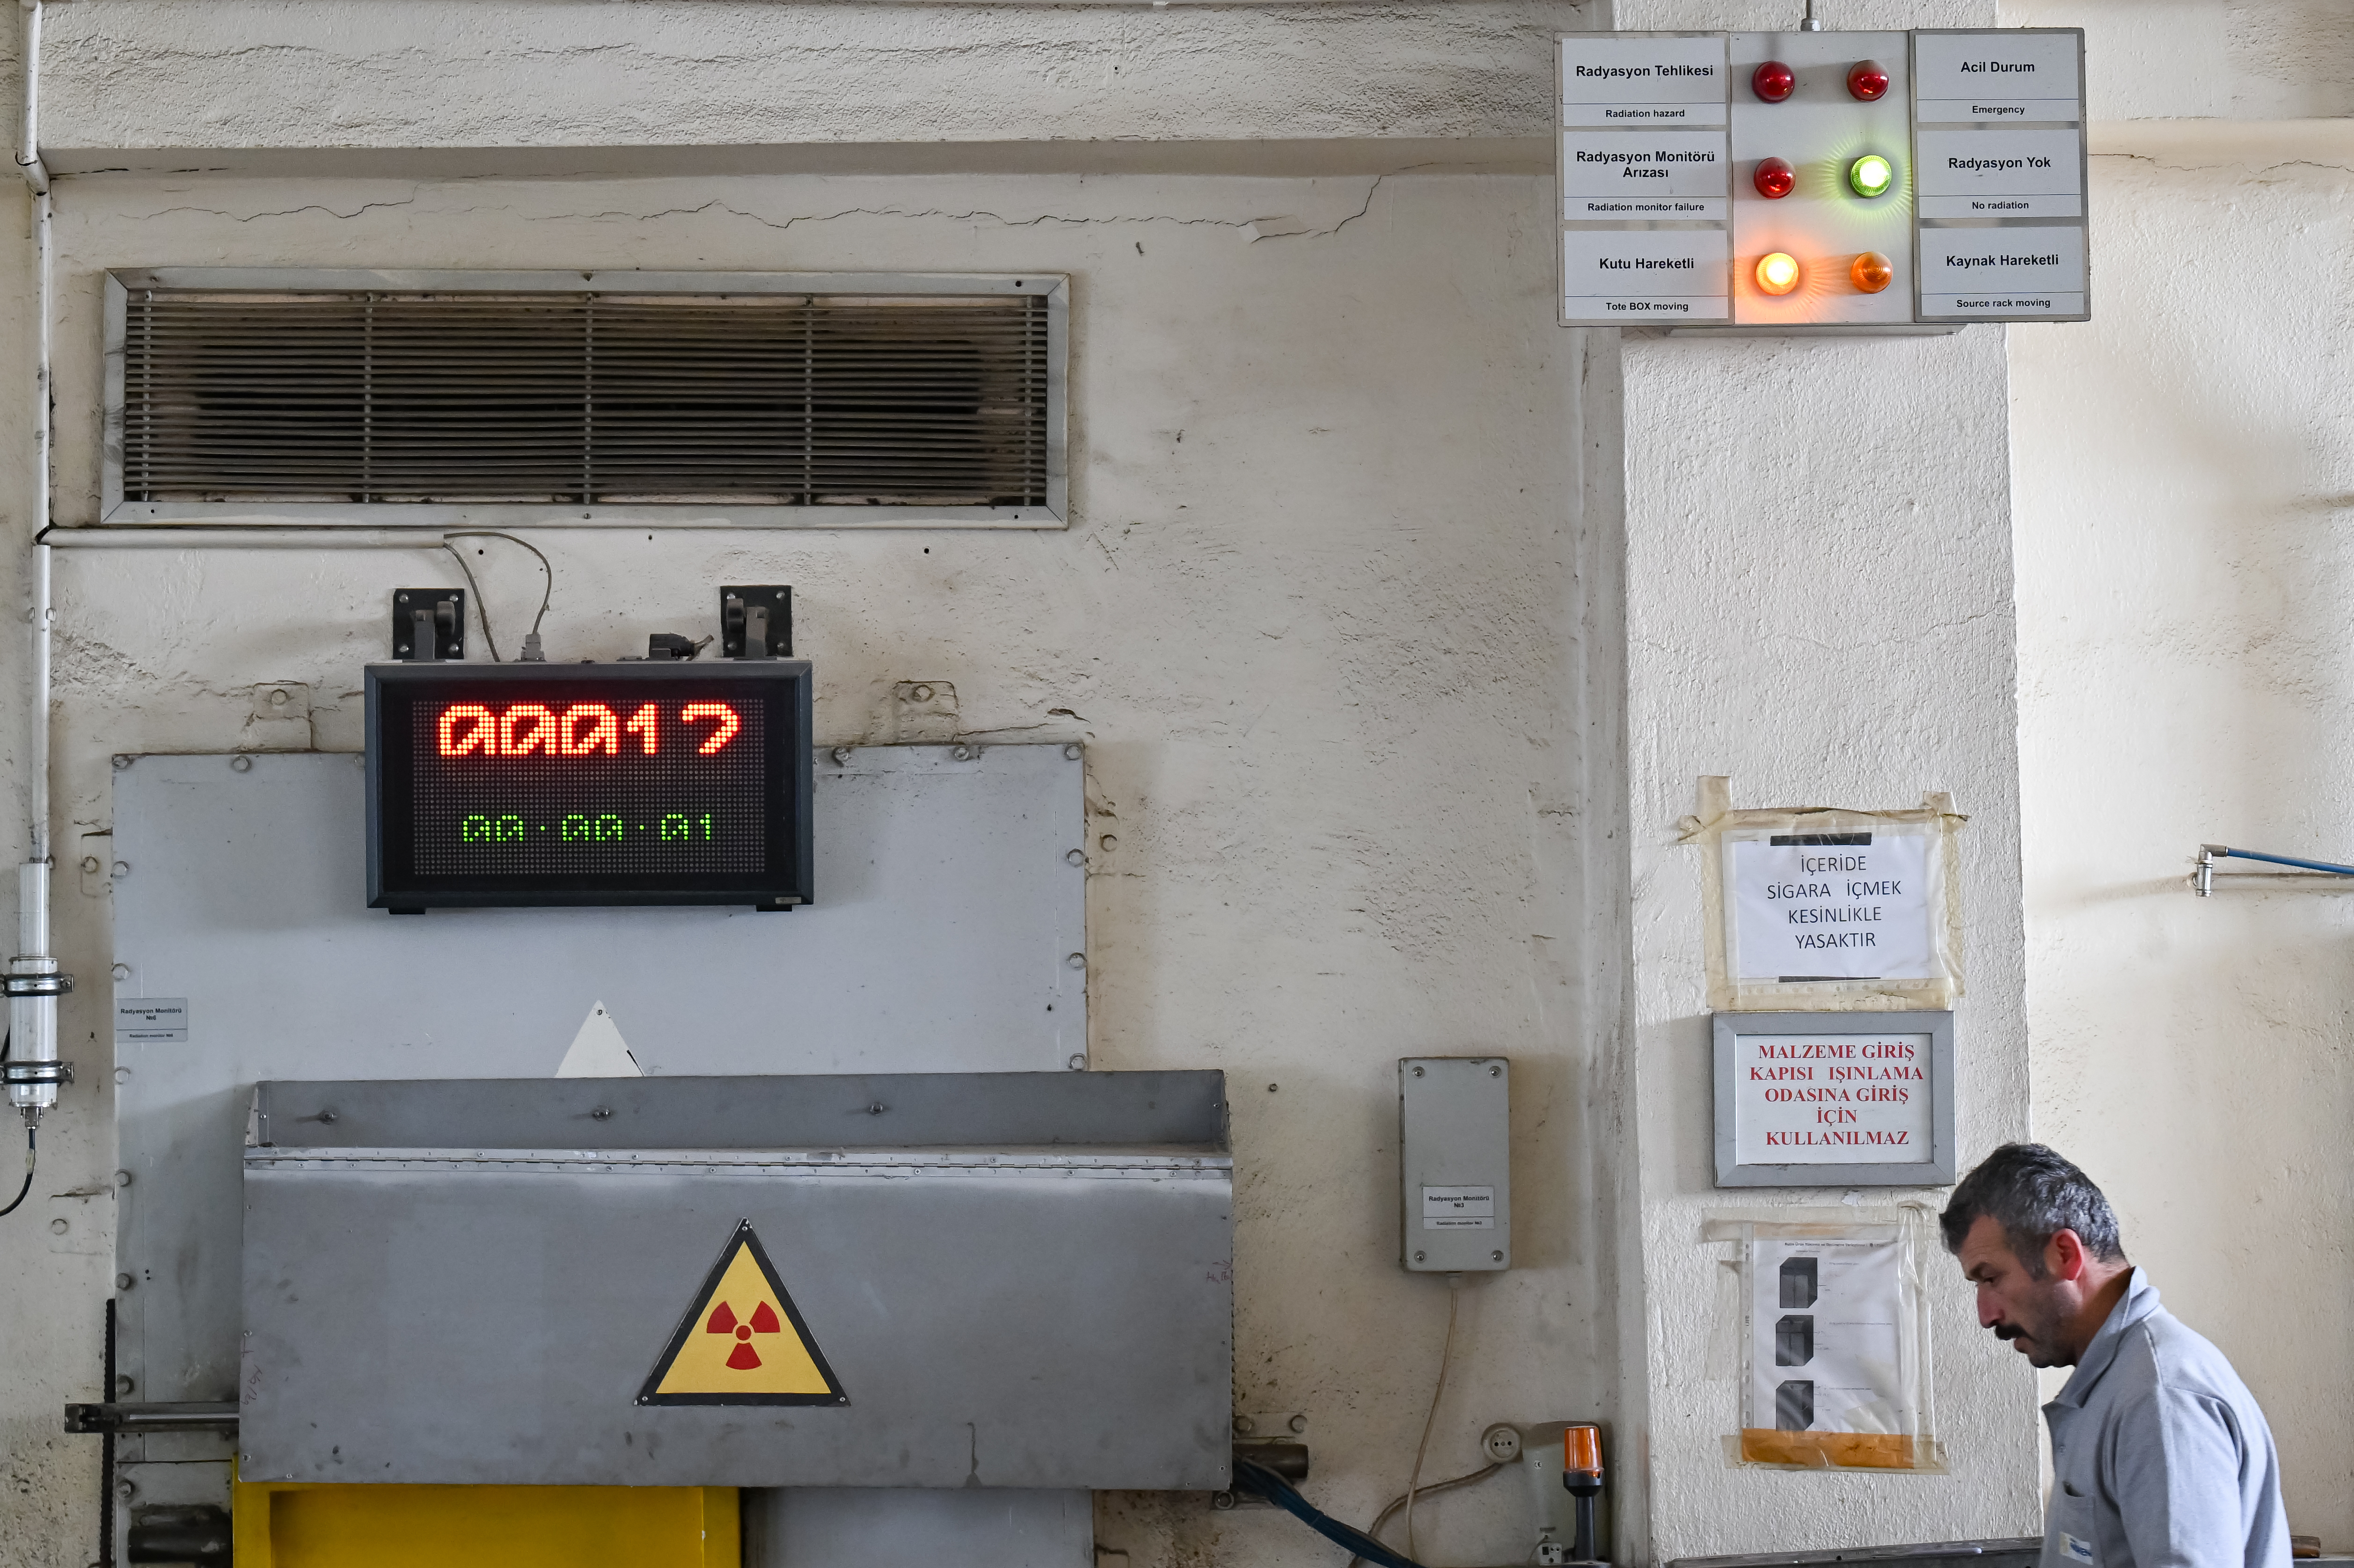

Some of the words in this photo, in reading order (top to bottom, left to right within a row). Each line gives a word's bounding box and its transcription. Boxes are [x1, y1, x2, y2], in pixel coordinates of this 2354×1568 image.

[1576, 66, 1650, 80] Radyasyon
[1654, 65, 1713, 76] Tehlikesi
[1960, 61, 1986, 73] Acil
[1990, 61, 2035, 73] Durum
[1653, 109, 1685, 117] hazard
[1972, 105, 2025, 115] Emergency
[1577, 149, 1651, 165] Radyasyon
[1655, 151, 1715, 162] Monitörü
[1947, 157, 2022, 171] Radyasyon
[2026, 156, 2051, 168] Yok
[1623, 167, 1668, 178] Arızası
[1587, 203, 1632, 211] Radiation
[1635, 203, 1672, 211] monitor
[1674, 203, 1704, 211] failure
[1972, 201, 1985, 210] No
[1988, 201, 2029, 209] radiation
[1600, 258, 1630, 269] Kutu
[1636, 258, 1694, 269] Hareketli
[1946, 255, 1996, 269] Kaynak
[2000, 254, 2059, 266] Hareketli
[1653, 302, 1689, 312] moving
[1993, 299, 2013, 307] rack
[2016, 299, 2050, 308] moving
[1801, 853, 1866, 876] İÇERİDE
[1767, 882, 1831, 899] SİGARA
[1847, 879, 1901, 900] İÇMEK
[1789, 904, 1882, 924] KESİNLİKLE
[1795, 932, 1876, 949] YASAKTIR
[1758, 1045, 1857, 1059] MALZEME
[1862, 1042, 1915, 1061] GİRİŞ
[1749, 1066, 1813, 1080] KAPISI
[1828, 1066, 1924, 1083] IŞINLAMA
[1765, 1088, 1850, 1101] ODASINA
[1856, 1084, 1909, 1104] GİRİŞ
[1816, 1106, 1857, 1127] İÇİN
[1767, 1131, 1908, 1145] KULLANILMAZ
